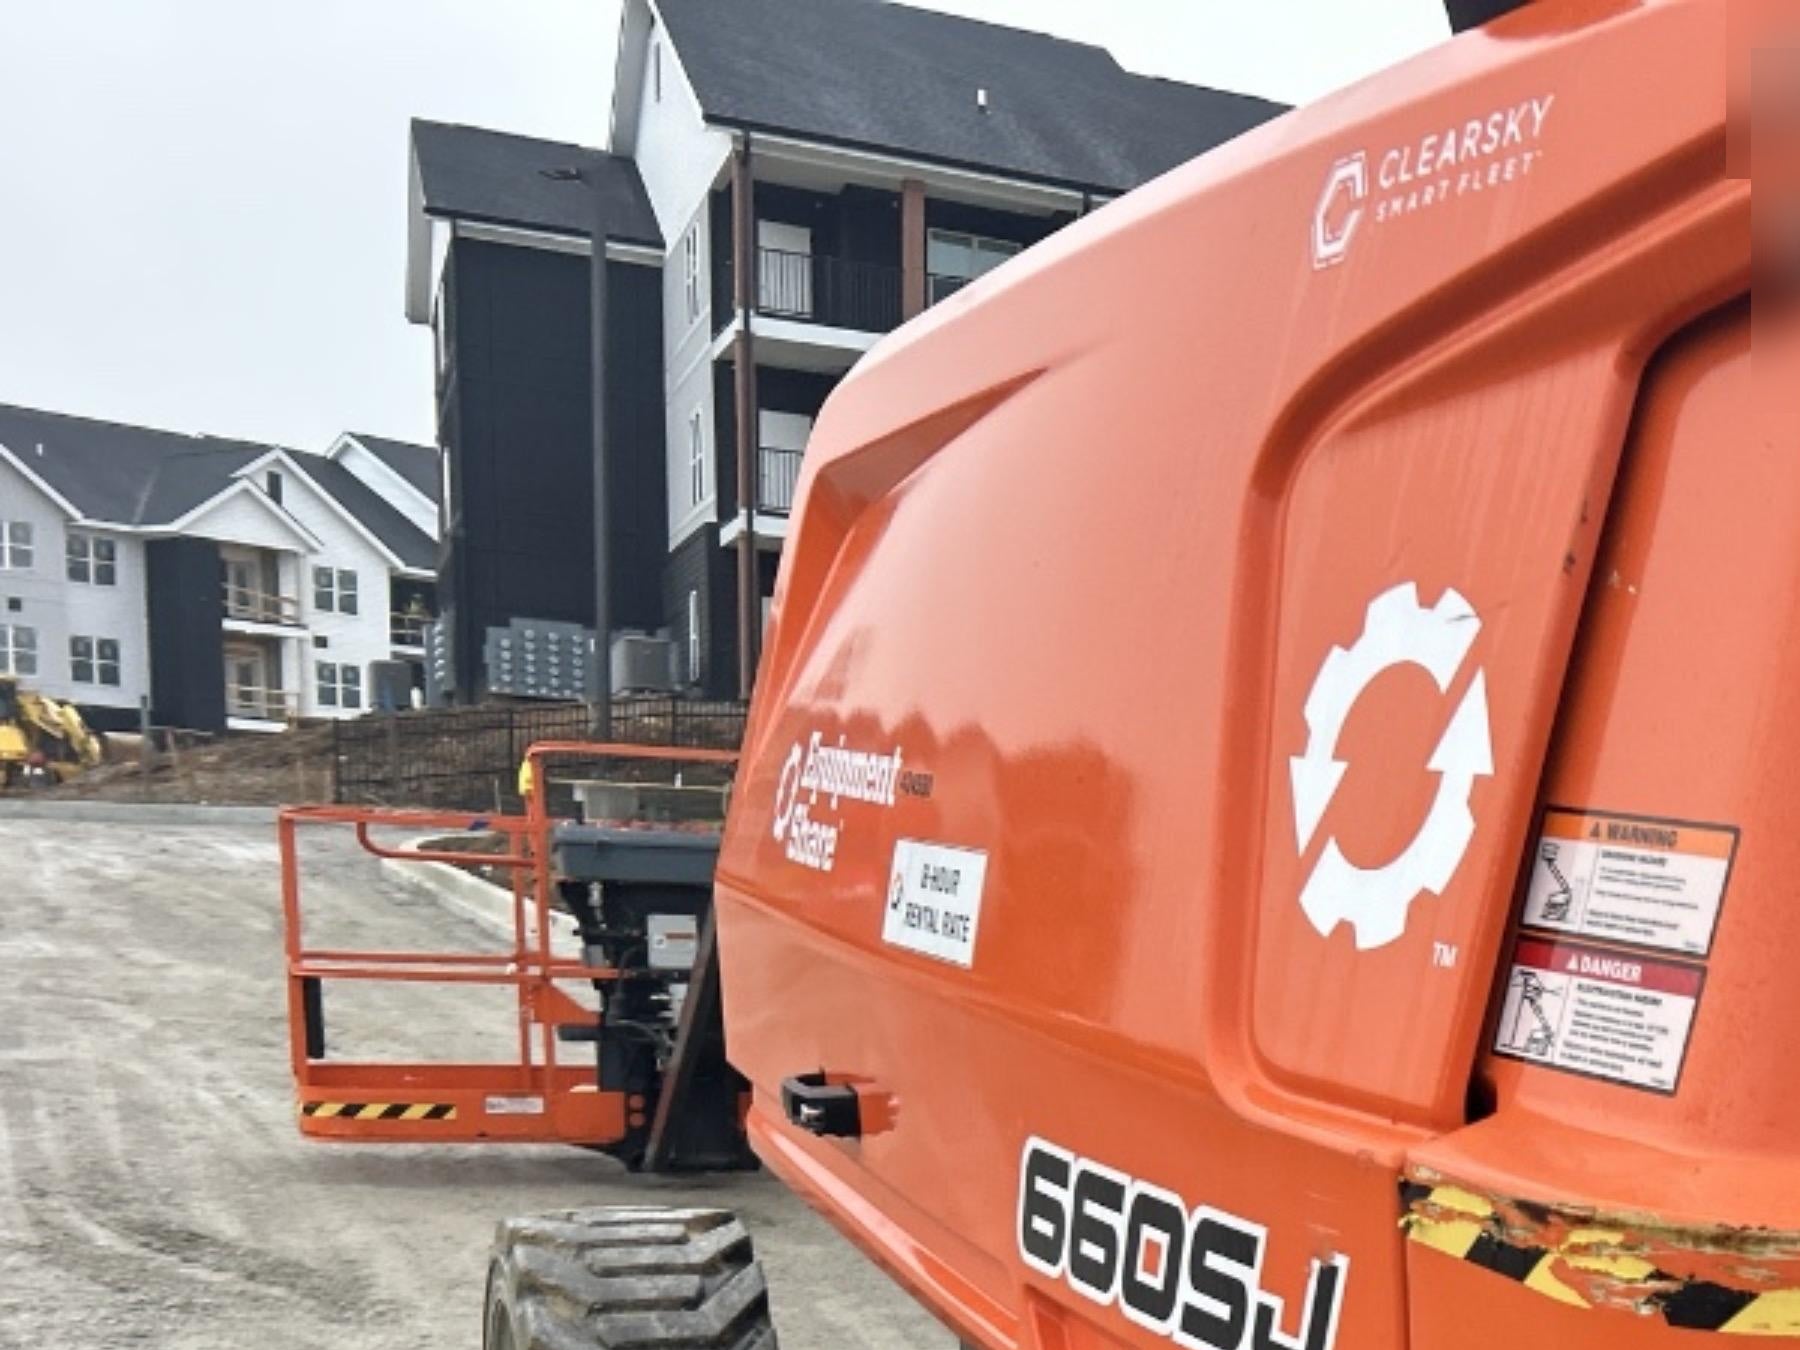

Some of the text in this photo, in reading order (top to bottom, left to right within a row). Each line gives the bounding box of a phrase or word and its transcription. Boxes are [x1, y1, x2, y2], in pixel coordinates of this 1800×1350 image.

[1378, 94, 1555, 190] CLEARSKY
[1376, 156, 1533, 223] SMART FLEET
[799, 731, 903, 811] Equipment
[785, 803, 839, 872] Share
[1607, 822, 1678, 848] WARNING
[903, 902, 971, 943] RENTAL RATE
[1580, 958, 1643, 984] DANGER
